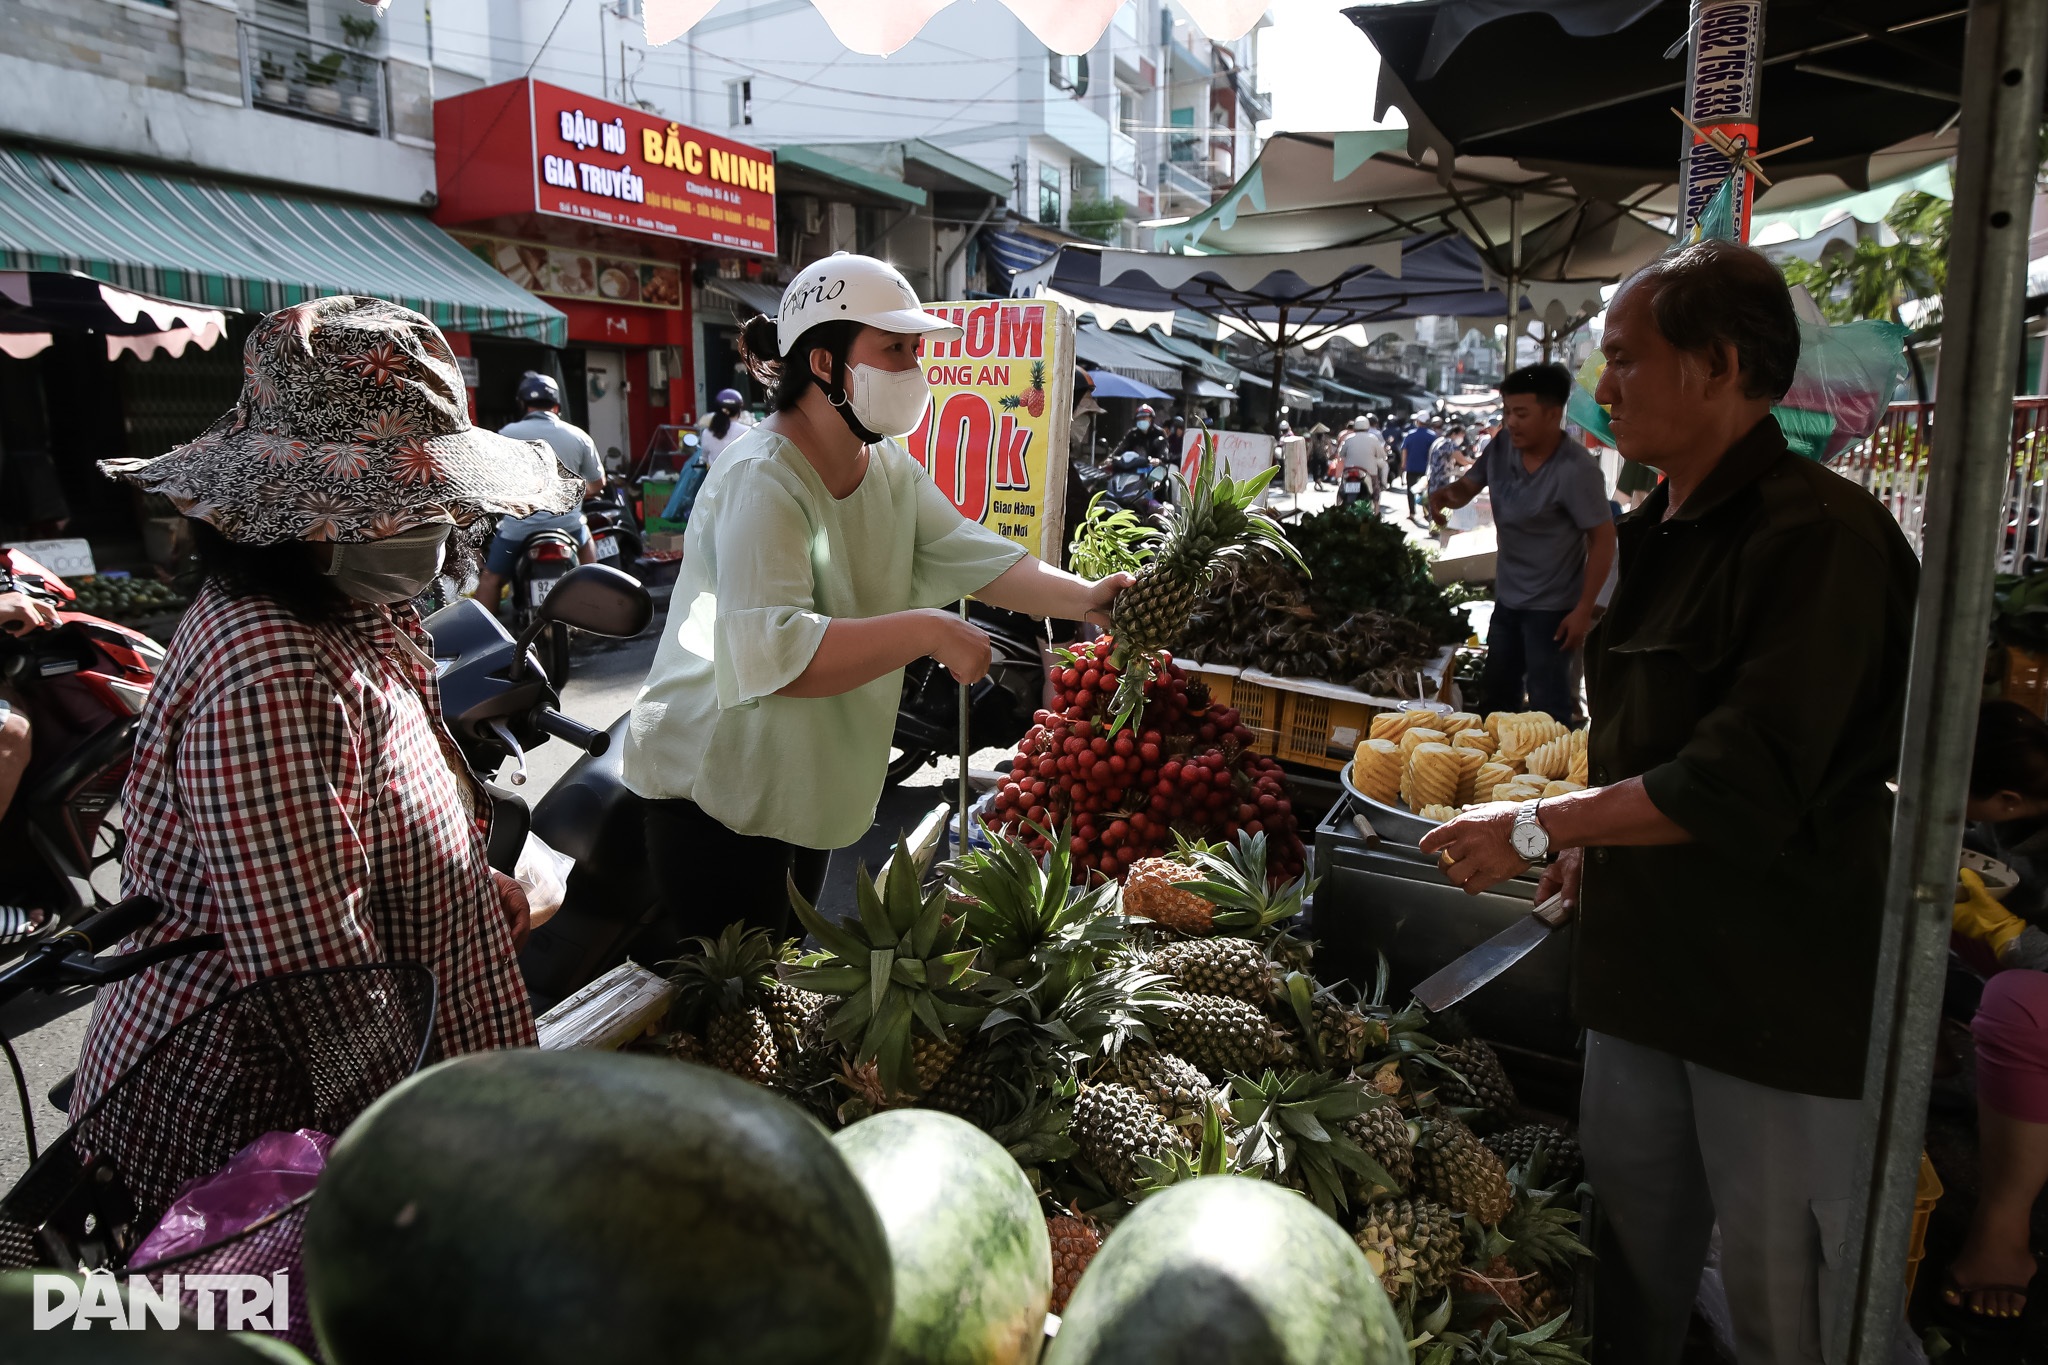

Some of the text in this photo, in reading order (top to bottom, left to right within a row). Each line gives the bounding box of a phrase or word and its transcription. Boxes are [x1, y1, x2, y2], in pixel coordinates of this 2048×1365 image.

[1693, 5, 1750, 119] 0982.756.333
[560, 109, 626, 155] ĐẬU HỦ
[544, 154, 578, 190] GIA
[642, 121, 774, 194] BẮC NINH
[976, 366, 1010, 386] AN
[994, 500, 1035, 518] Giao Hàng
[1013, 524, 1028, 537] Nơi
